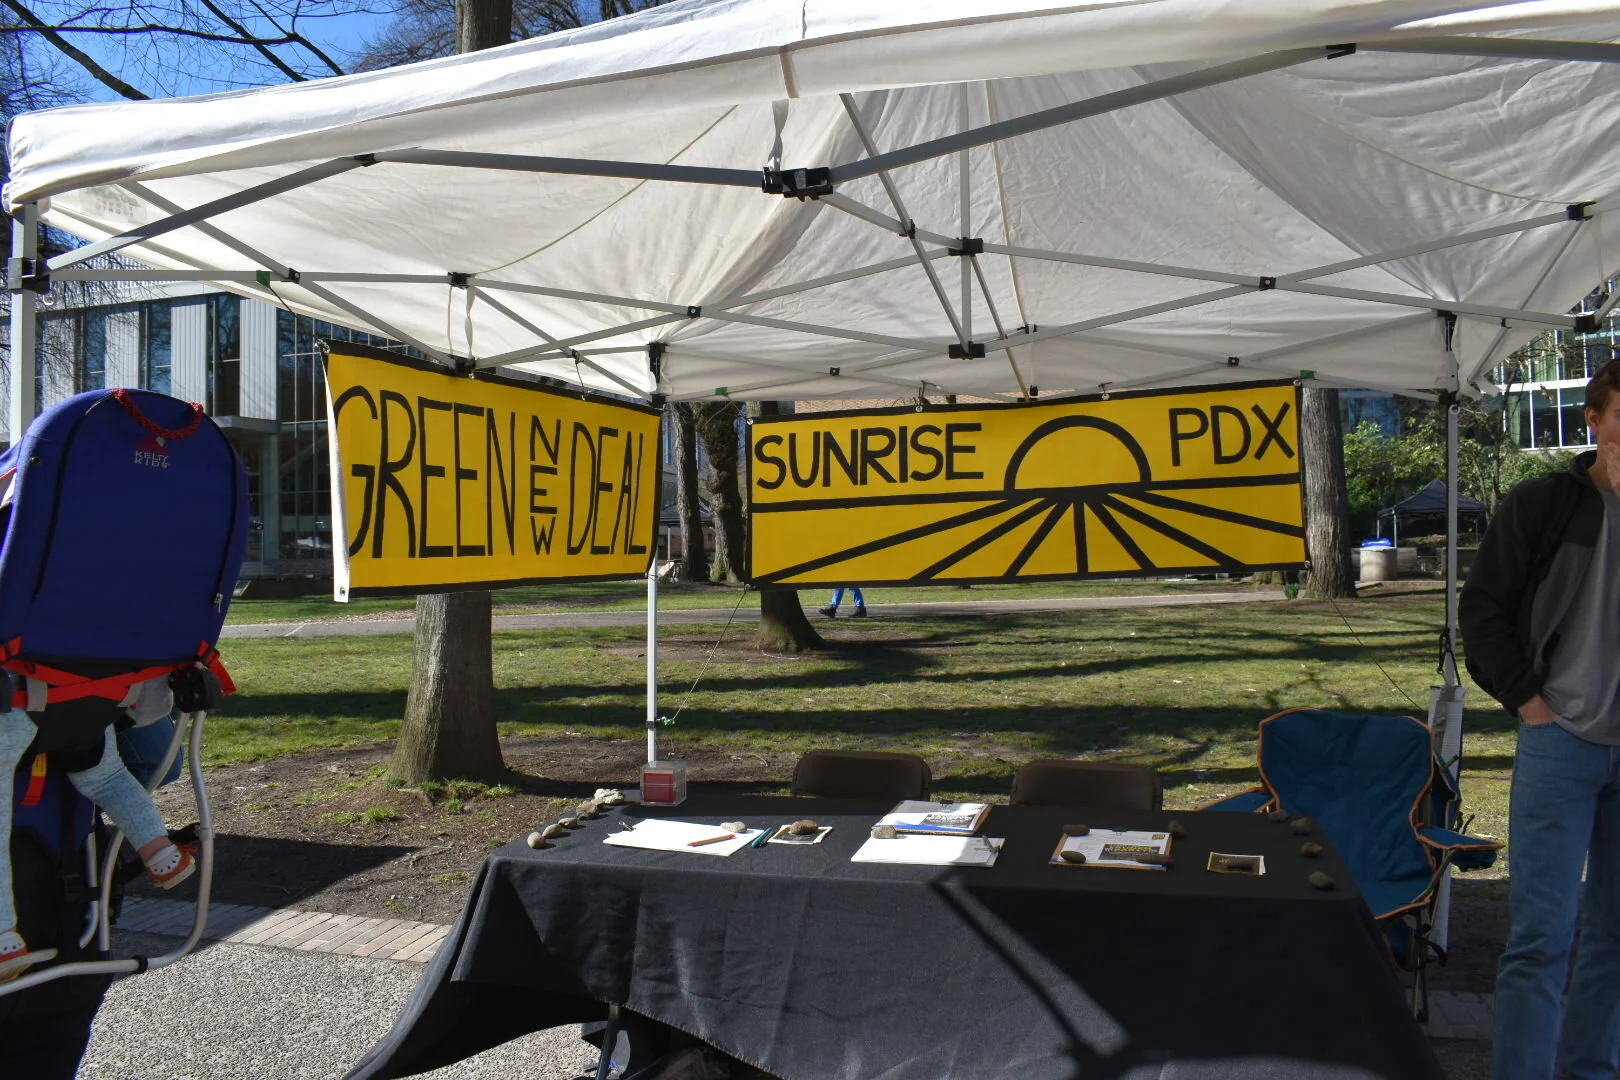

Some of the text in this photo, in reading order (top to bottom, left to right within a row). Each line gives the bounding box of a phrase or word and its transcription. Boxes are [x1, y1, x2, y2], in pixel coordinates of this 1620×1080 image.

[135, 450, 169, 462] KELTY
[333, 385, 647, 558] GREEN NEW DEAL
[754, 402, 1295, 490] SUNRISE PDX
